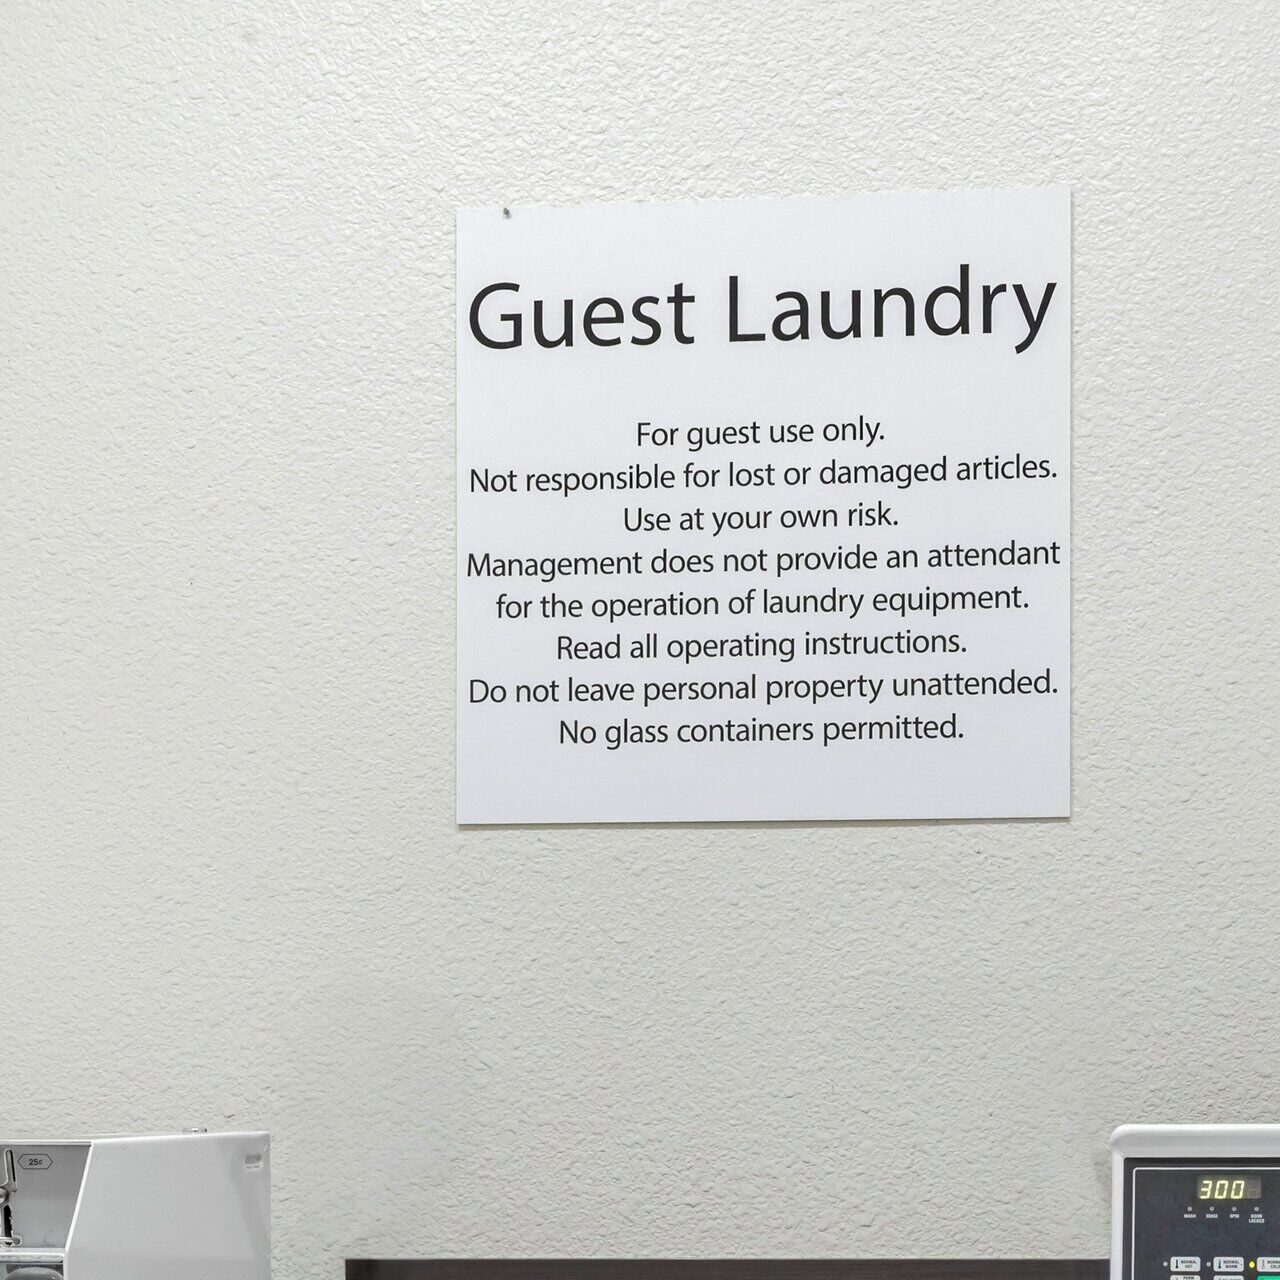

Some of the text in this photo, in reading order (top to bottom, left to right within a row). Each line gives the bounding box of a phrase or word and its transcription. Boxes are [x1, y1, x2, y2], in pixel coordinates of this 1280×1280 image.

[469, 263, 1058, 355] Guest Laundry
[637, 414, 885, 453] For guest use only.
[470, 452, 1057, 498] Not responsible for lost or damaged articles.
[624, 500, 899, 537] Use at your own risk.
[467, 539, 1061, 583] Management does not provide an attendant
[495, 585, 1029, 624] for the operation of laundry equipment.
[557, 629, 967, 665] Read all operating instructions.
[469, 667, 1058, 708] Do not leave personal property unattended.
[559, 712, 964, 751] No glass containers permitted.
[1199, 1180, 1245, 1199] 300
